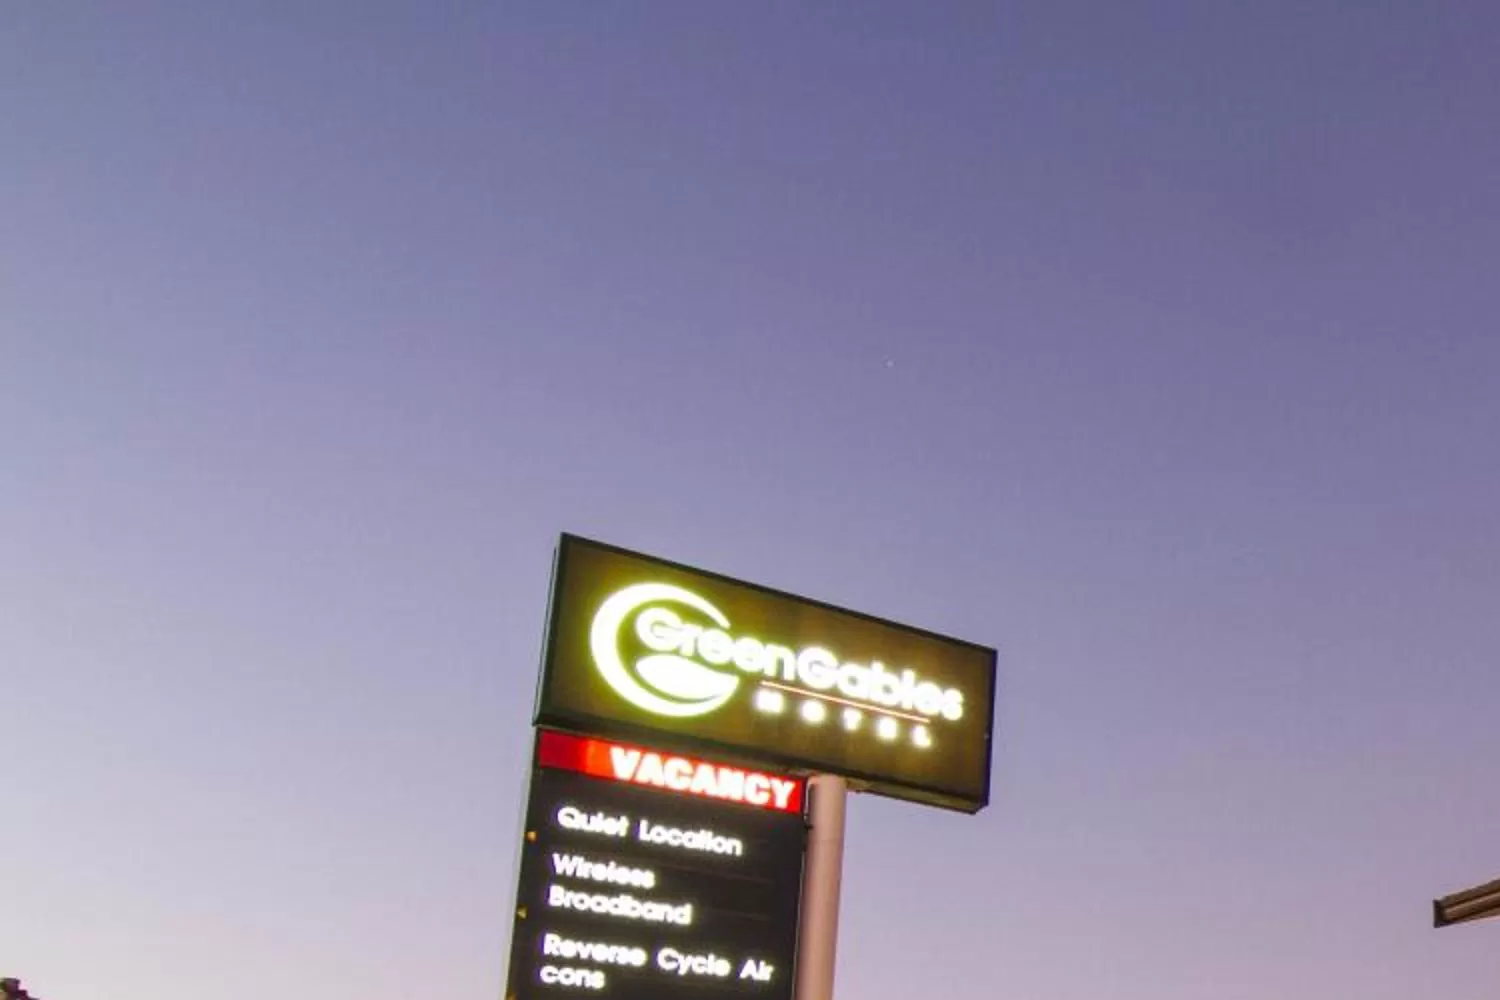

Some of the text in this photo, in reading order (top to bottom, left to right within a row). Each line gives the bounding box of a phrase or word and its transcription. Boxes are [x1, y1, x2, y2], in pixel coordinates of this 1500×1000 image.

[755, 691, 932, 748] MOTEL
[610, 747, 795, 808] VACANCY
[557, 807, 743, 855] Quiet Location
[552, 854, 656, 887] Wireless
[549, 886, 693, 924] Broadband
[540, 967, 605, 989] cons
[544, 934, 774, 981] Reverse Cycle Air
